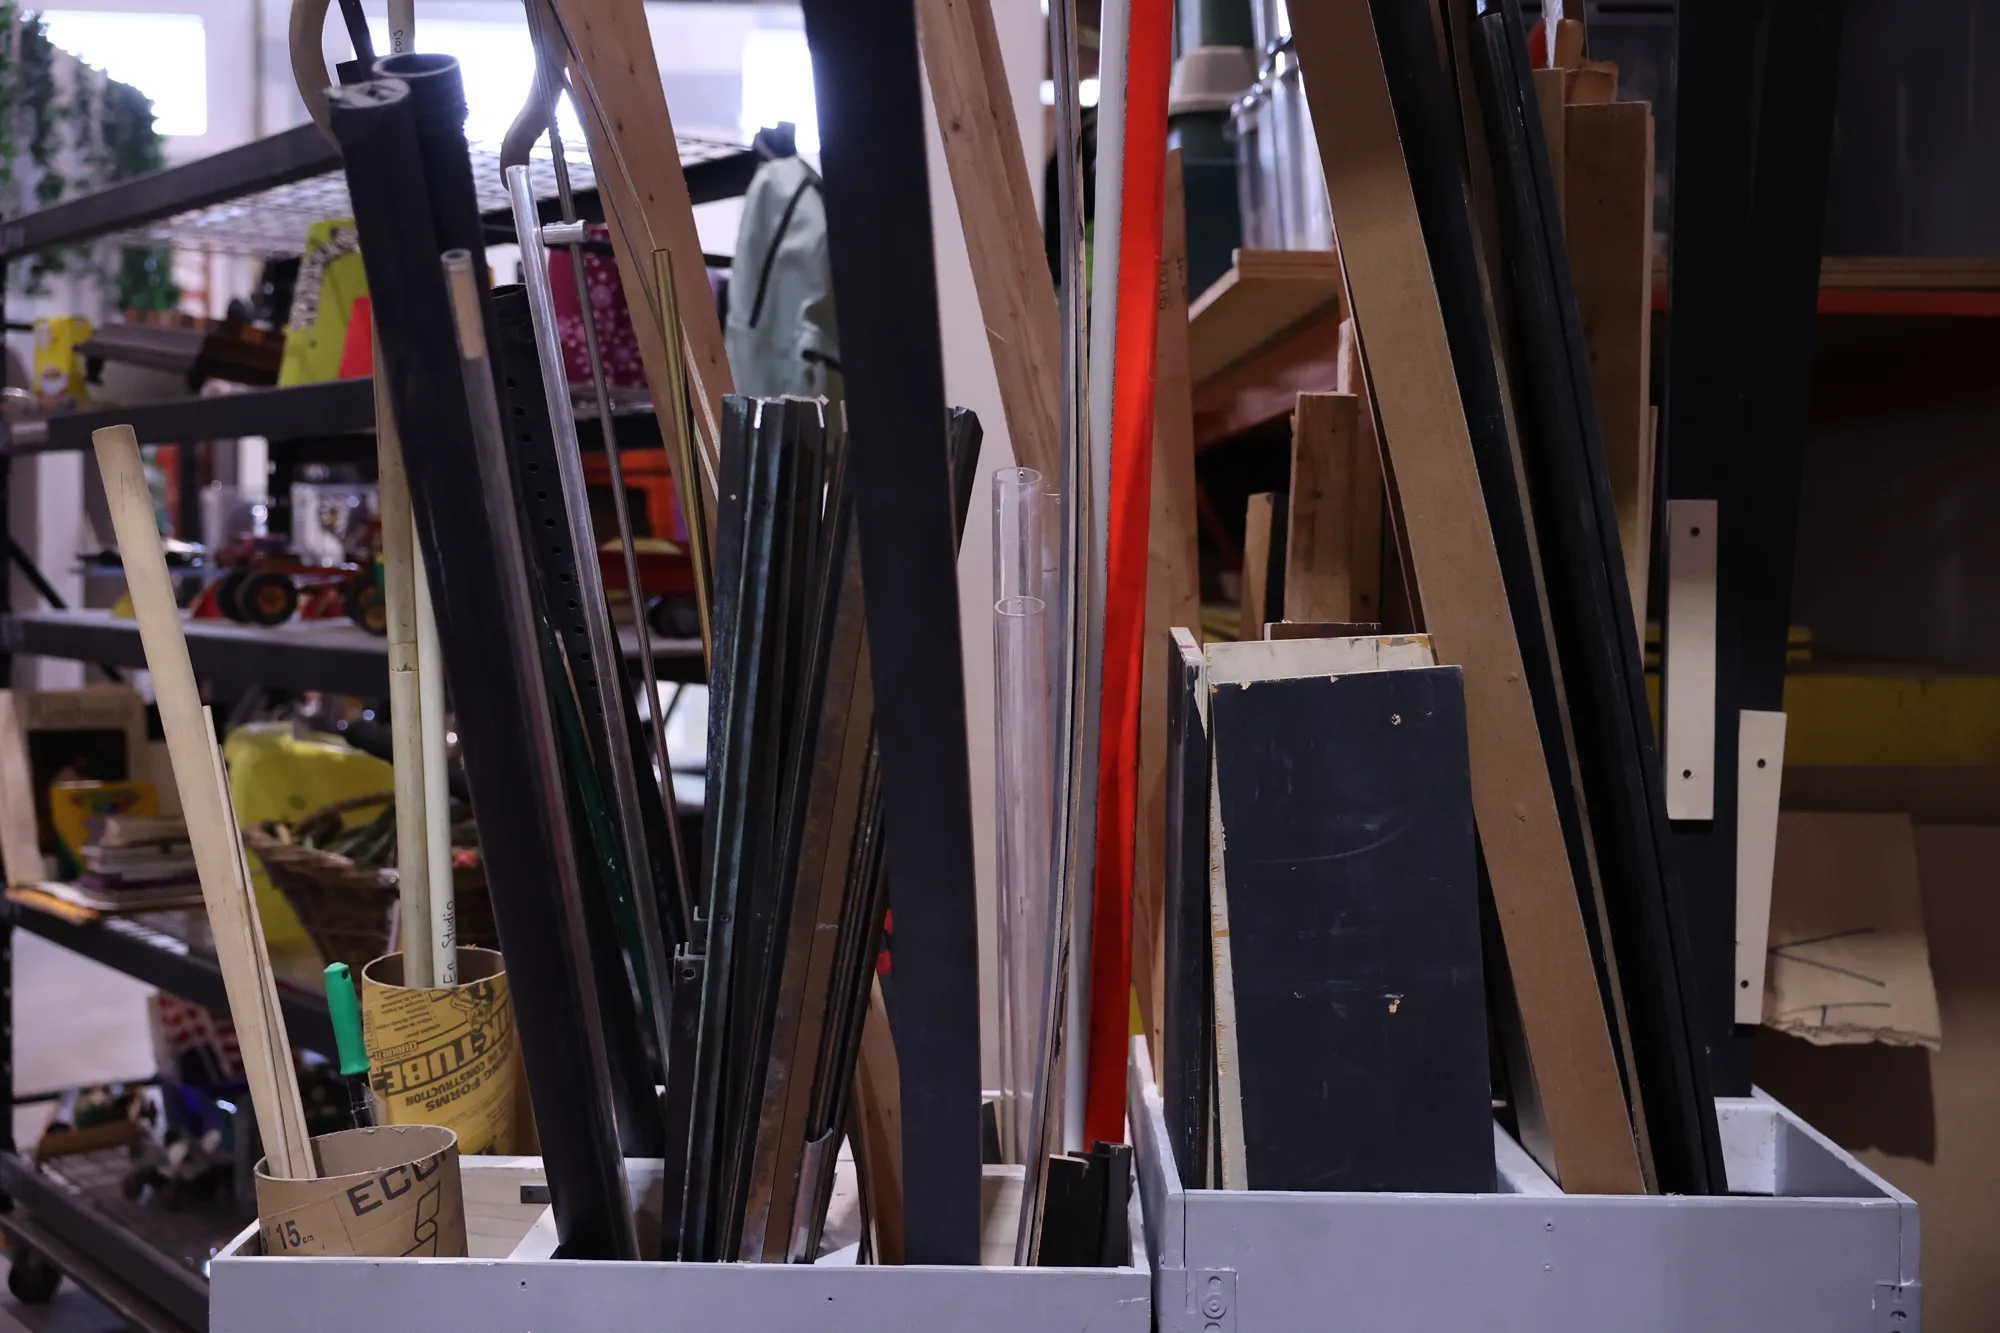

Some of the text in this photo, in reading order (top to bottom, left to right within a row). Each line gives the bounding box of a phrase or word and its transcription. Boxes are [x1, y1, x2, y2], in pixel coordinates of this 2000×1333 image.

[441, 900, 457, 984] En Studio
[406, 1061, 486, 1106] CONSTRUCTION
[425, 1077, 481, 1112] FORMS
[276, 1220, 301, 1250] 15
[302, 1234, 315, 1244] cm
